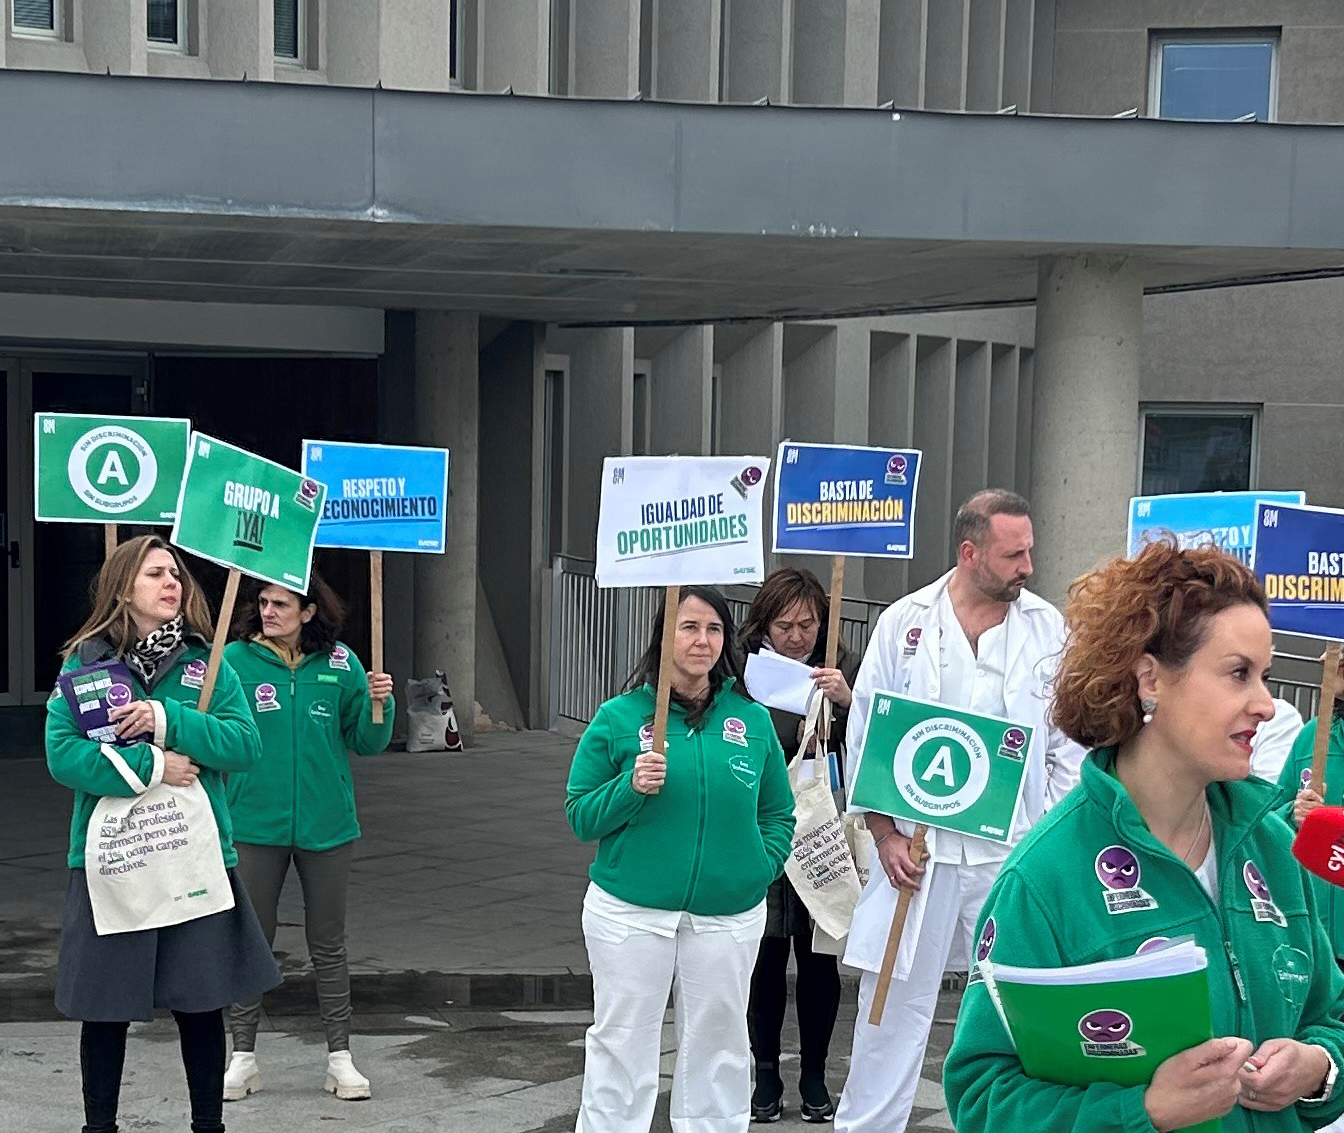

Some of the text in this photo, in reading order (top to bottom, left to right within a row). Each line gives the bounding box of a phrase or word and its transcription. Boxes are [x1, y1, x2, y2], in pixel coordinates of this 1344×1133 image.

[96, 450, 130, 486] A
[342, 477, 407, 498] RESPETO Y
[820, 480, 858, 501] BASTA
[858, 479, 874, 500] DE
[223, 480, 271, 515] GRUPO
[270, 493, 281, 520] A
[323, 496, 437, 520] ECONOCIMIENTO
[641, 492, 725, 526] IGUALDAD DE
[786, 495, 904, 525] DISCRIMINACIÓN
[235, 510, 265, 545] ¡YA!
[1263, 508, 1279, 529] 8M
[617, 513, 749, 556] OPORTUNIDADES
[1241, 525, 1251, 546] Y
[911, 728, 925, 742] SIN
[925, 723, 982, 759] DISCRIMINACIÓN
[920, 745, 955, 788] A
[147, 800, 166, 812] son
[167, 797, 178, 808] el
[127, 820, 137, 832] la
[138, 809, 185, 830] profesión
[802, 820, 834, 843] mujeres
[144, 829, 167, 844] pero
[168, 822, 189, 837] solo
[813, 840, 824, 850] de
[822, 834, 832, 844] la
[98, 852, 106, 863] el
[126, 844, 155, 859] ocupa
[156, 838, 189, 851] cargos
[800, 843, 840, 871] enfermera
